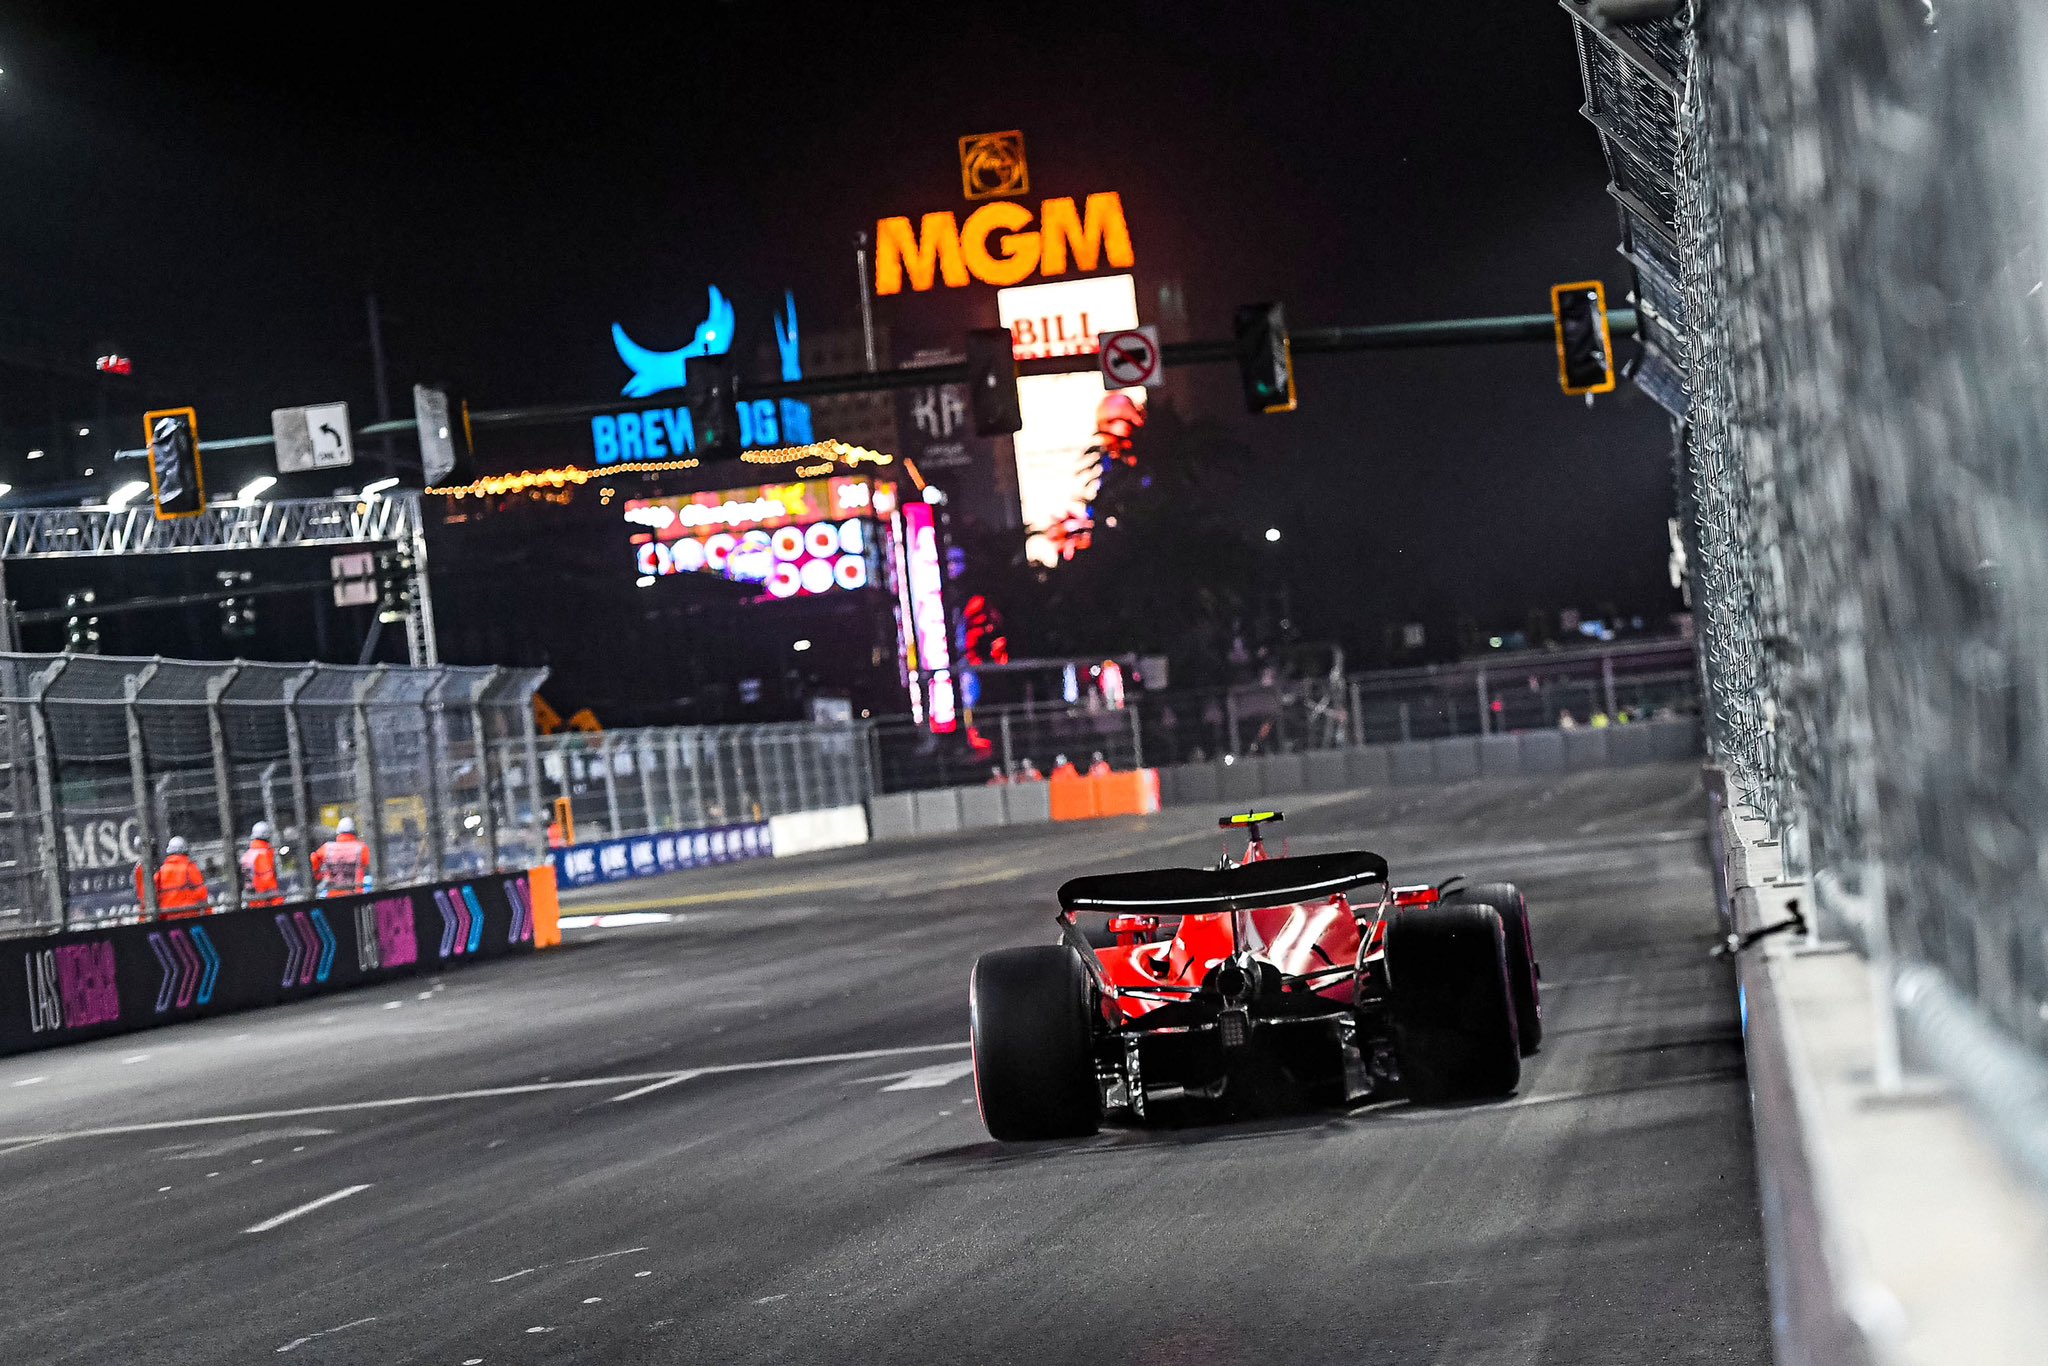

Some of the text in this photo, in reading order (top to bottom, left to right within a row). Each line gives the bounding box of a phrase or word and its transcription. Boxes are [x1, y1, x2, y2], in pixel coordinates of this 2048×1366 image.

[875, 191, 1135, 296] MGM
[64, 817, 143, 871] MSC
[25, 949, 61, 1033] LAS
